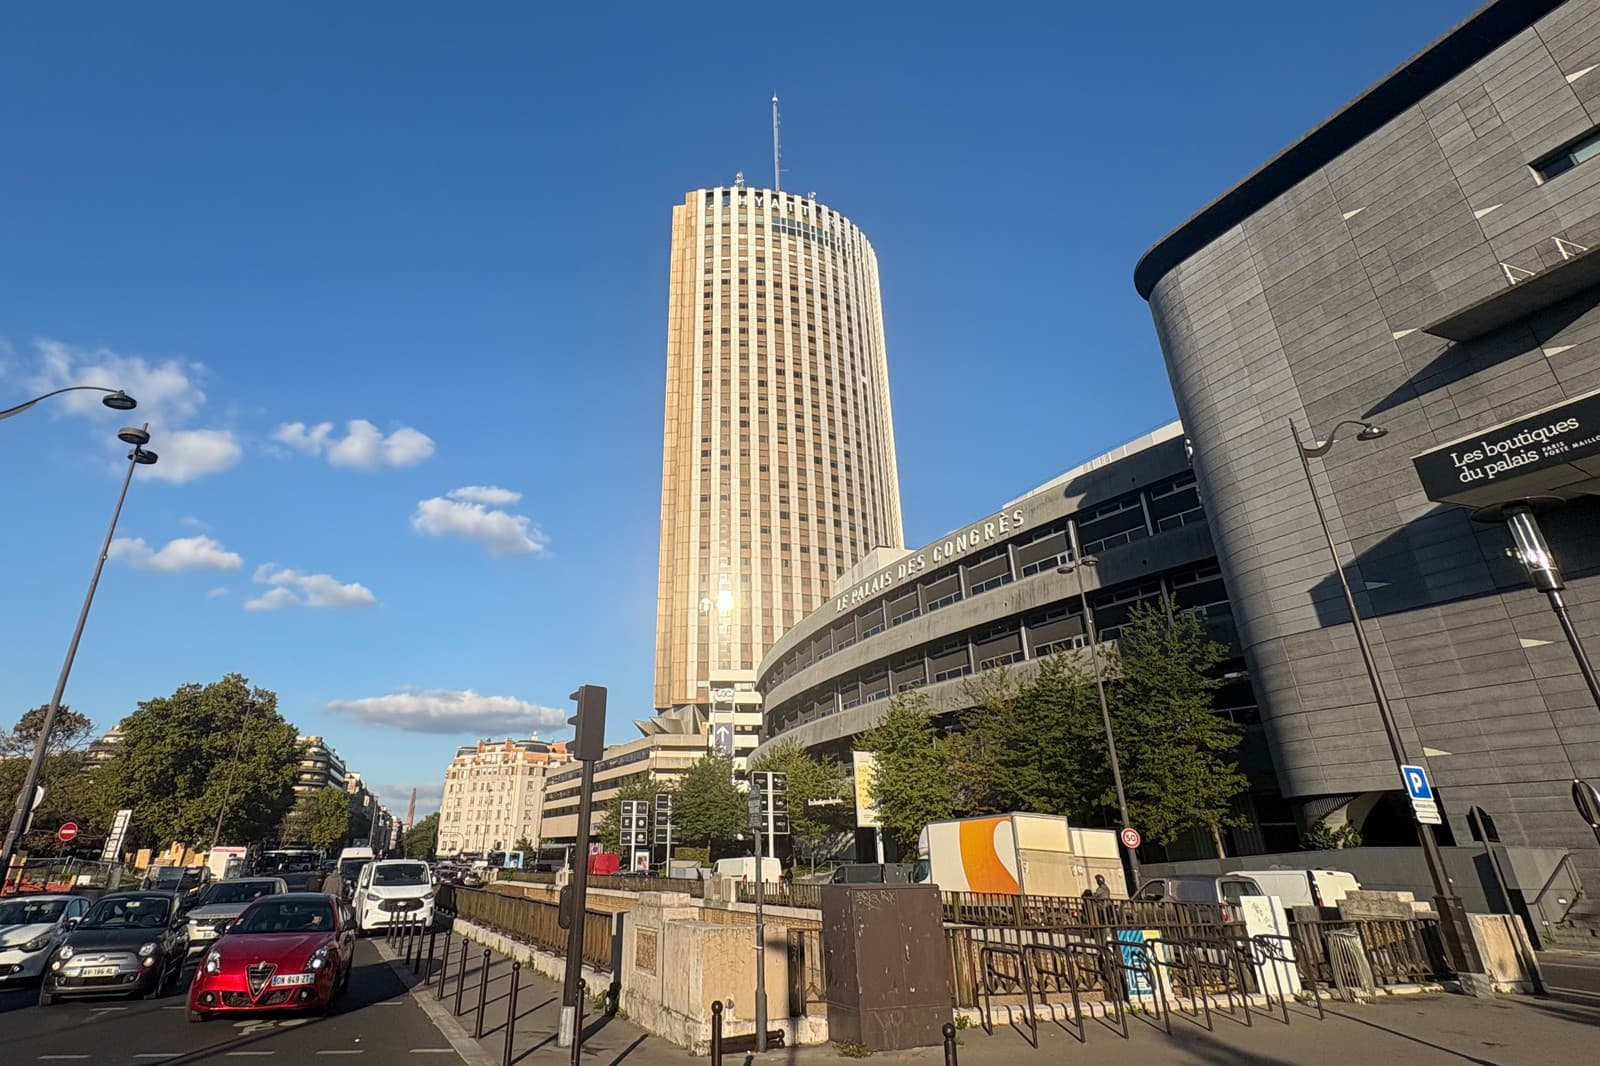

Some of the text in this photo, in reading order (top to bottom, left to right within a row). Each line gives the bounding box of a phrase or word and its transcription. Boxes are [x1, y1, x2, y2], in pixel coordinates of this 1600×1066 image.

[738, 195, 808, 216] HYATT
[1450, 417, 1580, 468] Les boutiques
[1541, 441, 1565, 452] PARIS
[1544, 445, 1569, 458] PORTE
[1459, 449, 1540, 483] du palais
[836, 508, 1025, 614] LE PALAIS DES CONGRÈS
[1409, 772, 1423, 794] P
[1126, 834, 1136, 842] 50
